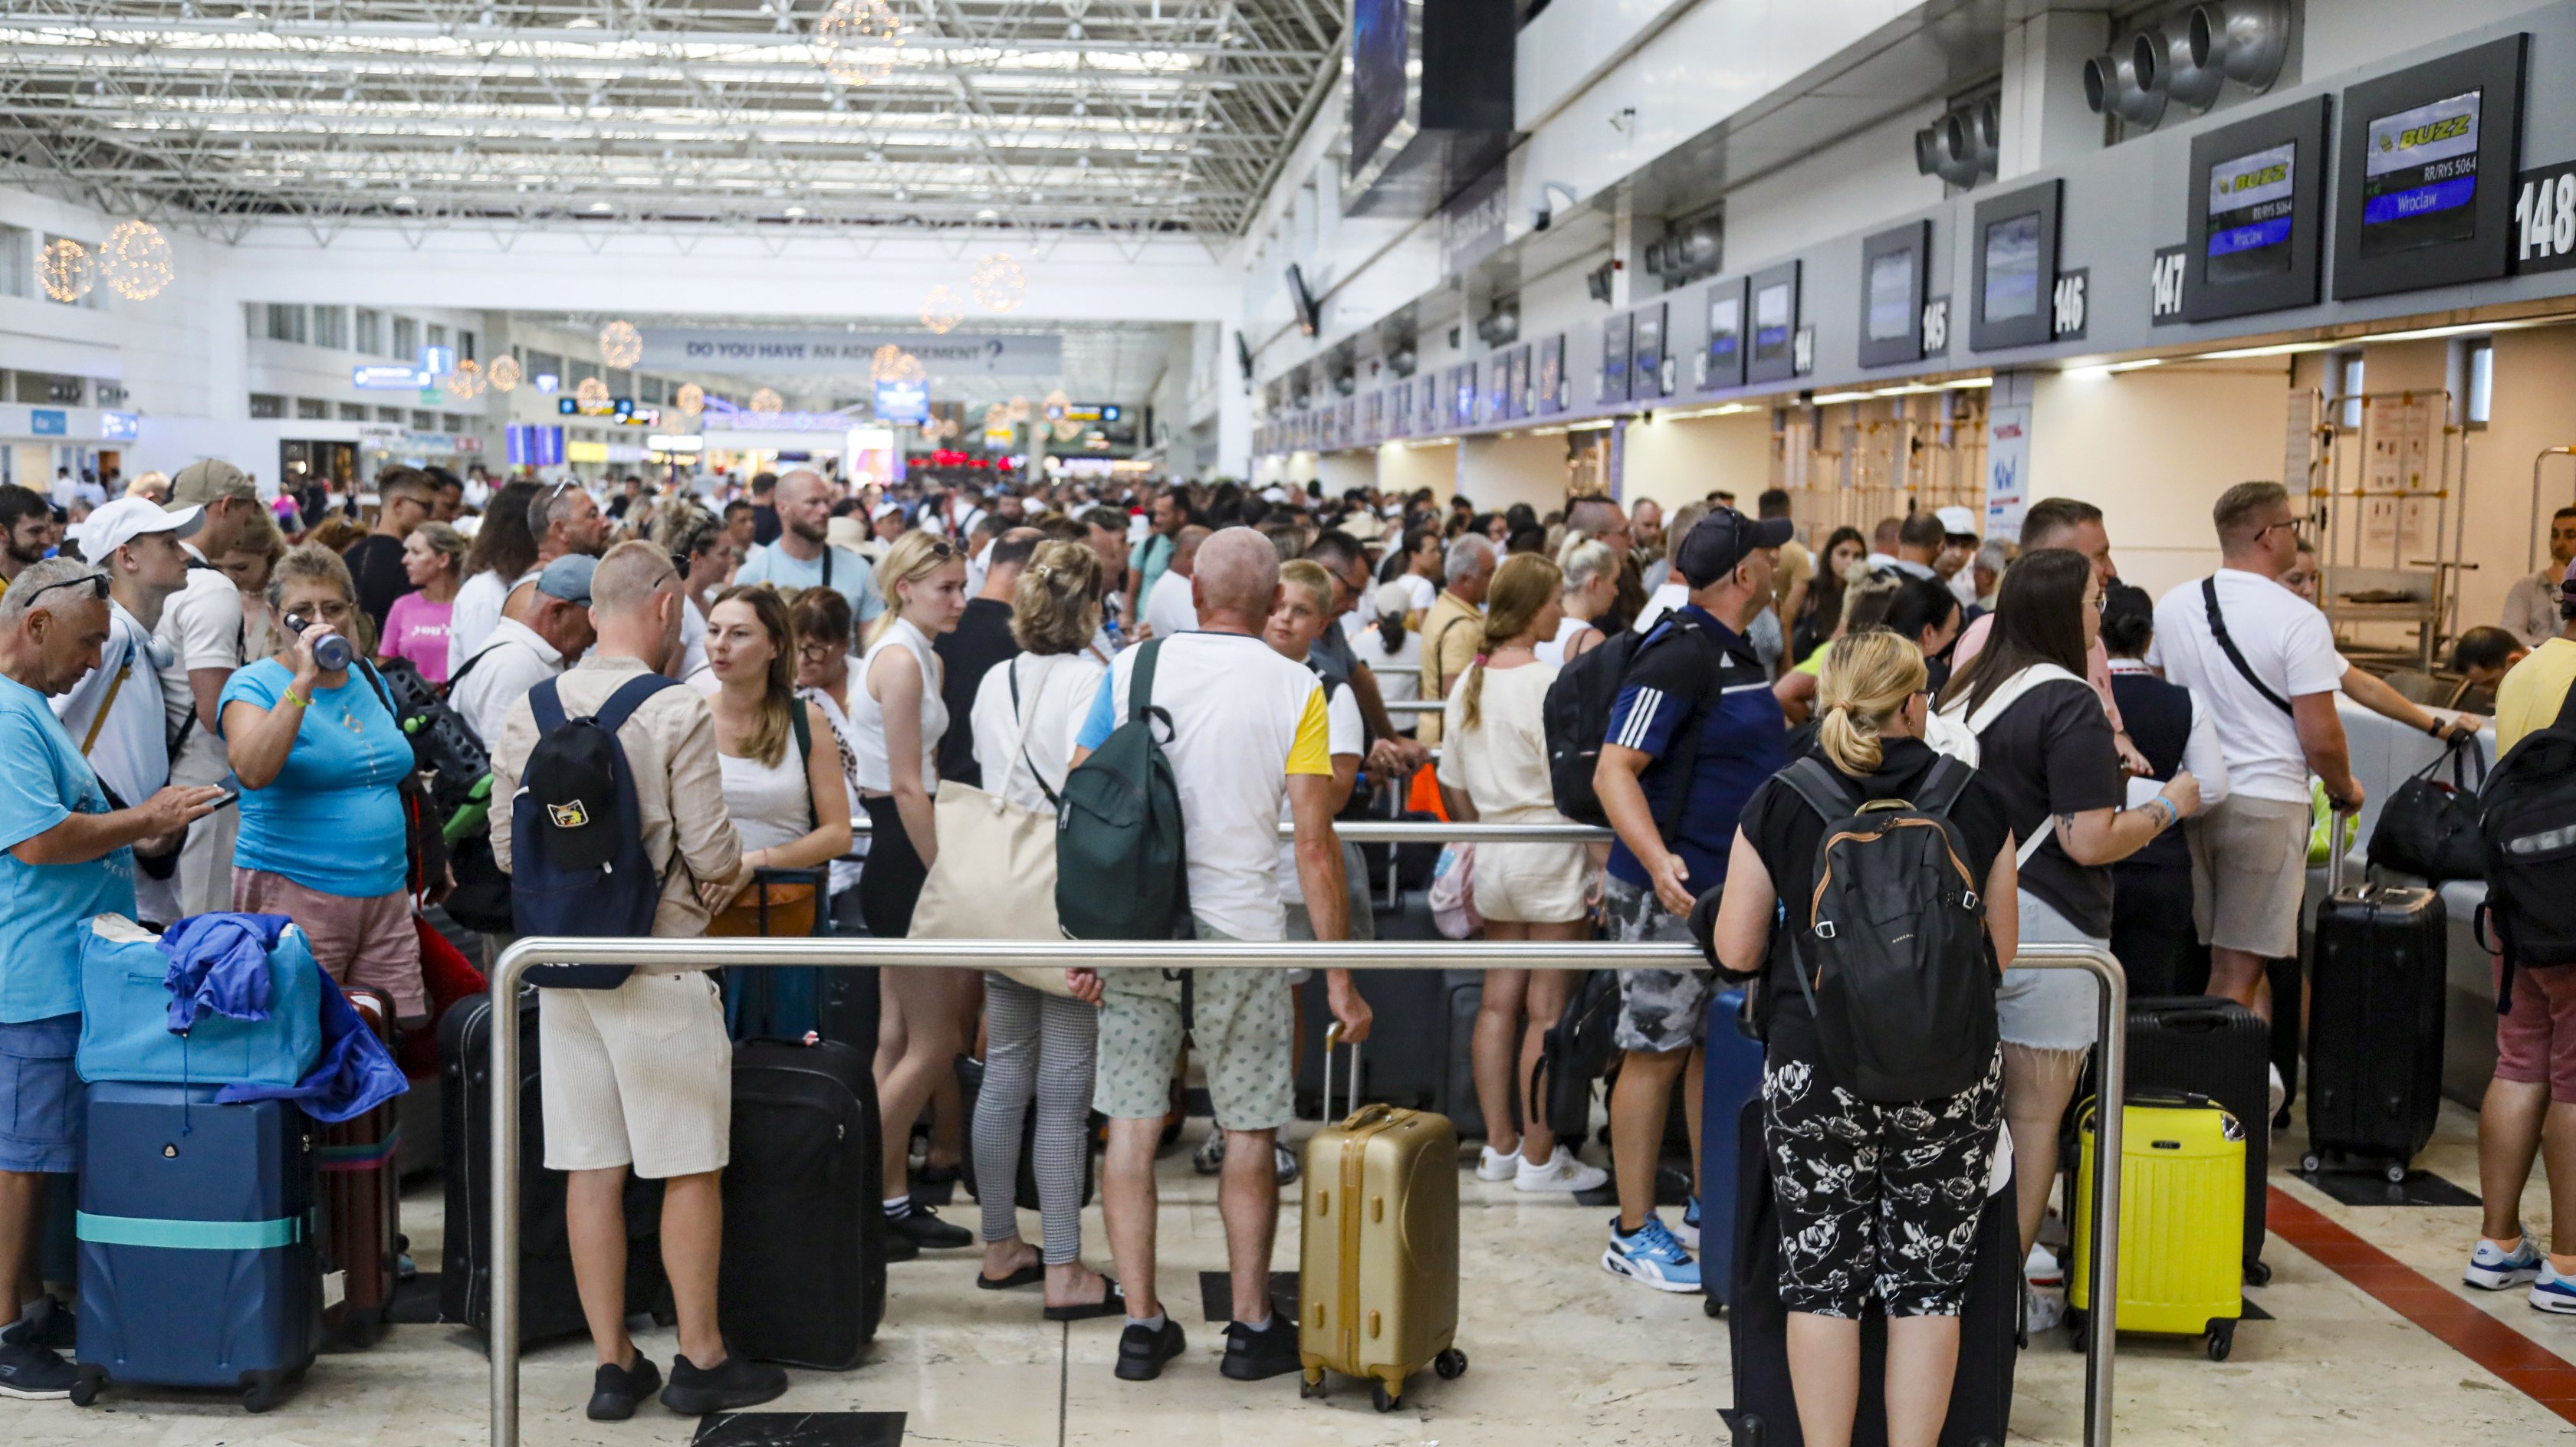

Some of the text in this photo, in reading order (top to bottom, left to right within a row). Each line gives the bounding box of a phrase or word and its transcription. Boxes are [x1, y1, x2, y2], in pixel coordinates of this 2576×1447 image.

[2398, 113, 2472, 151] BUZZ
[2233, 162, 2288, 192] BUZZ
[2424, 156, 2476, 182] RR/RYS 5064
[2397, 192, 2437, 214] Wroclaw
[2515, 172, 2576, 261] 148
[2151, 253, 2186, 316] 147
[2053, 275, 2085, 333] 146
[687, 342, 713, 357] DO
[717, 343, 756, 358] YOU
[758, 343, 804, 358] HAVE
[813, 344, 836, 358] AN
